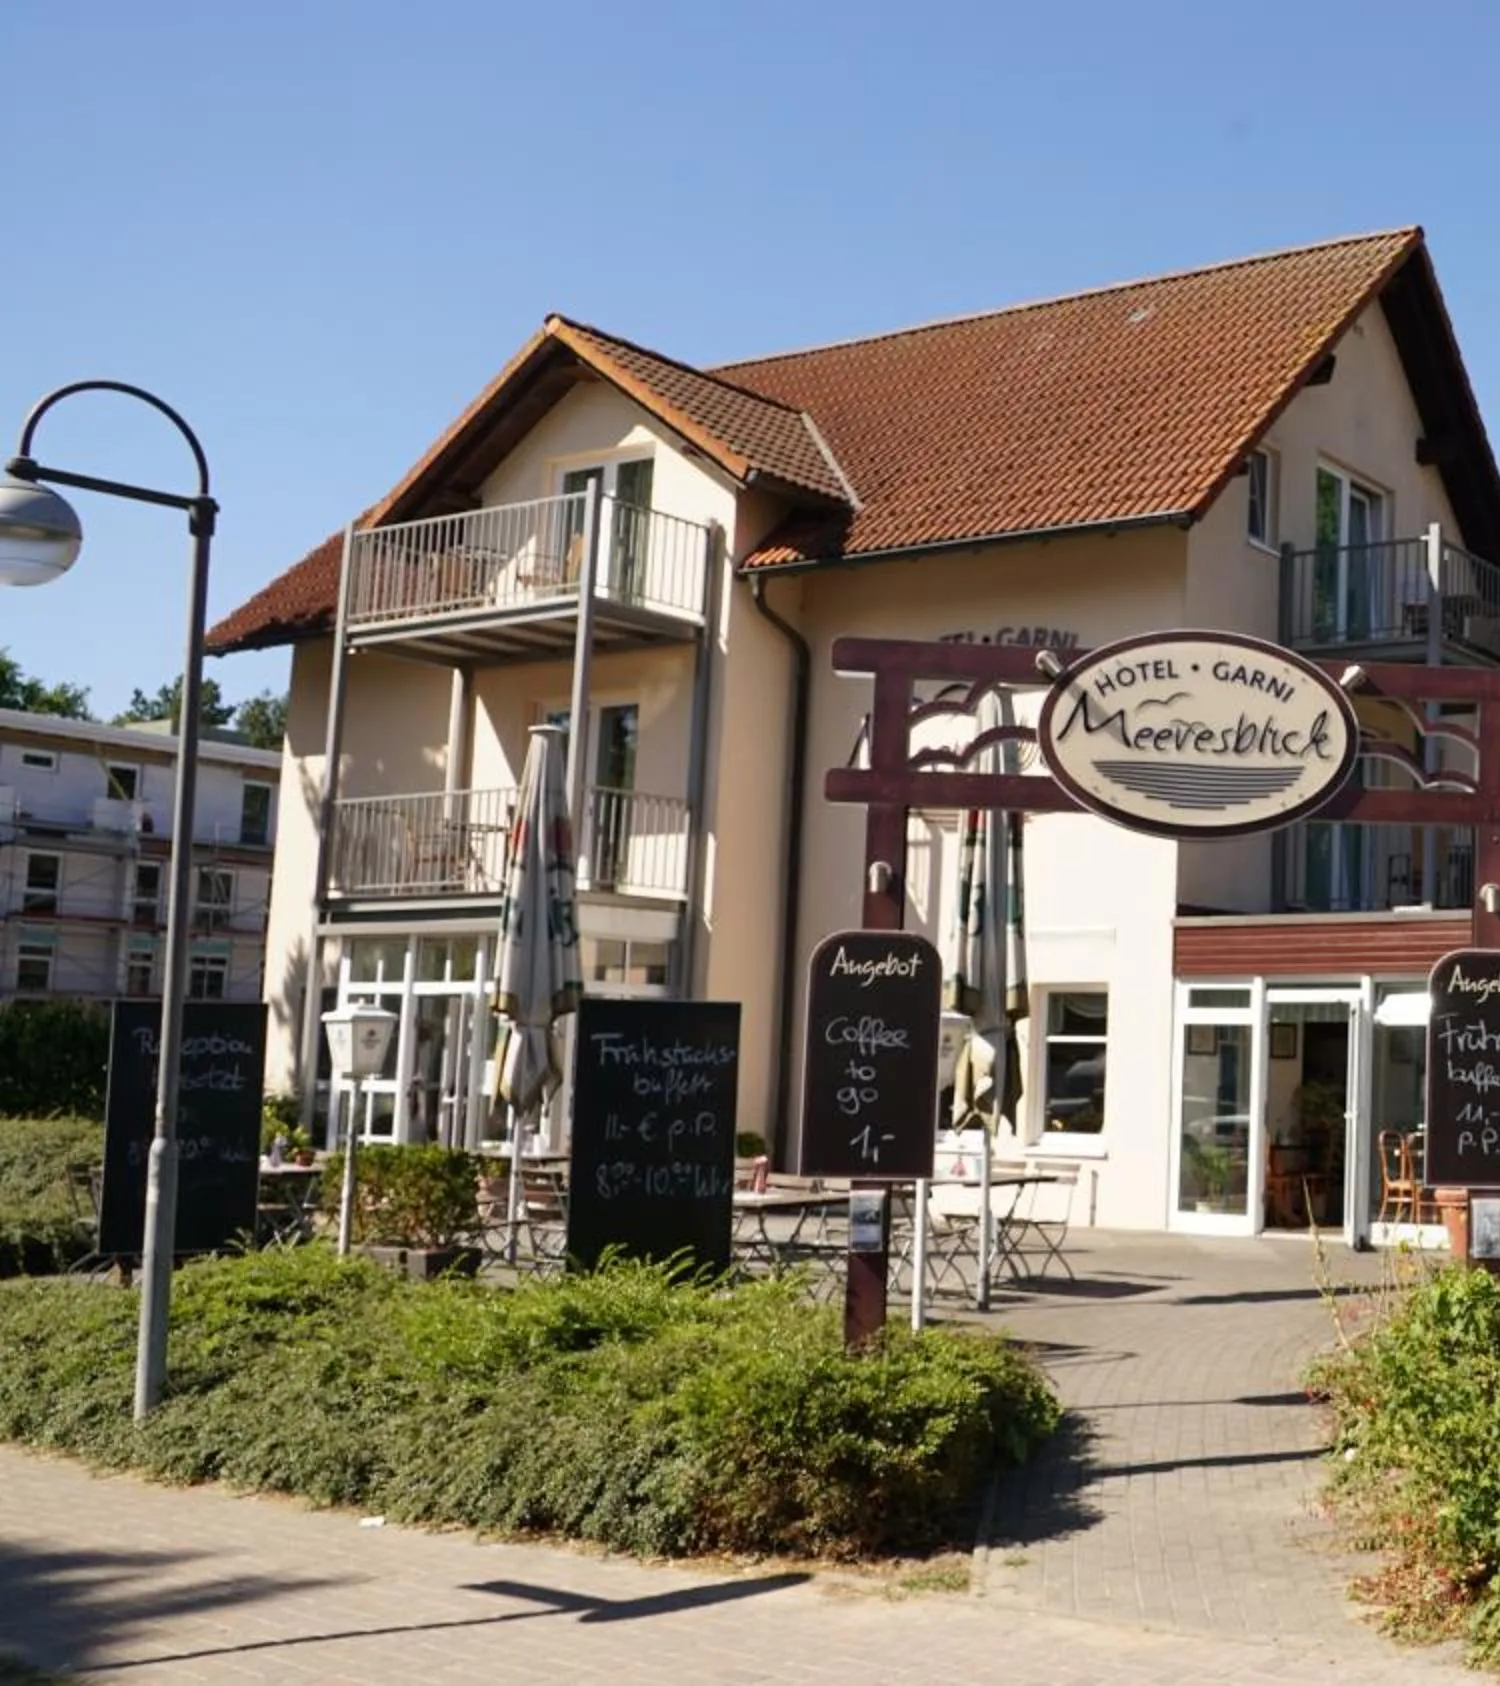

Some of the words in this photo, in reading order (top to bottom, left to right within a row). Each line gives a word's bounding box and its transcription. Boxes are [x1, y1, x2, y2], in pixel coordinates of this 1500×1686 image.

[1094, 659, 1179, 698] HOTEL
[1212, 660, 1297, 703] GARNI
[829, 945, 923, 988] Angebot
[824, 1015, 911, 1056] Coffee
[844, 1060, 877, 1081] to
[835, 1086, 879, 1115] go
